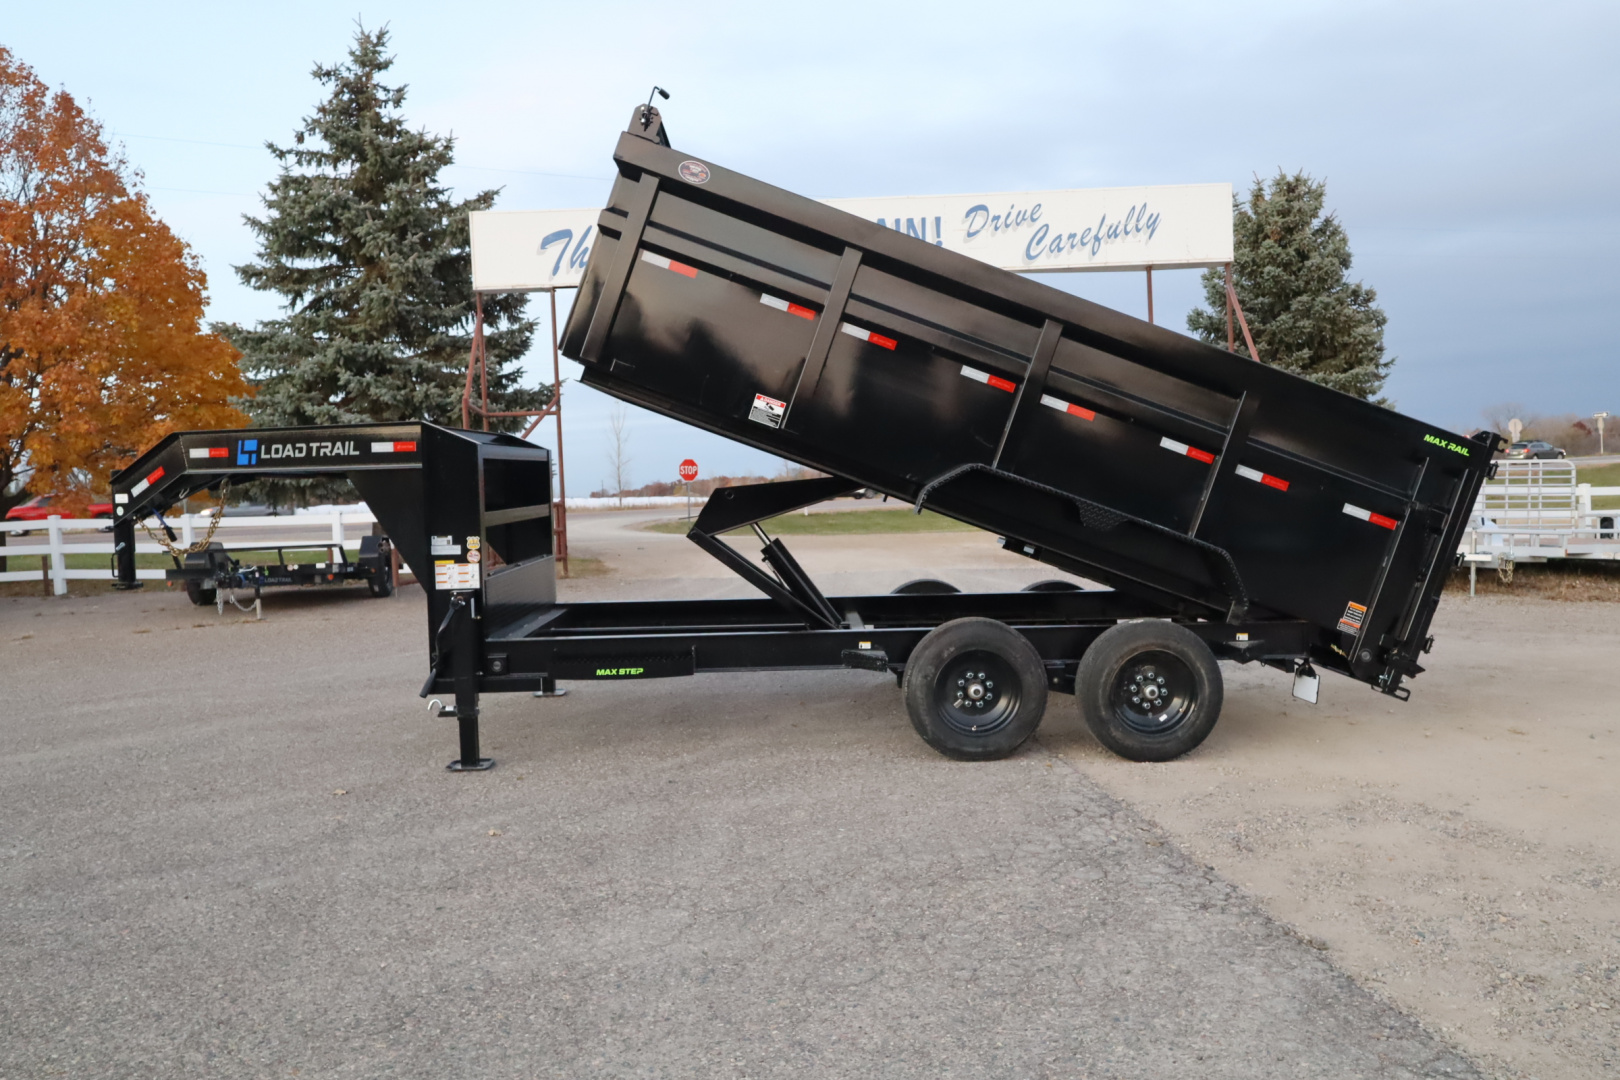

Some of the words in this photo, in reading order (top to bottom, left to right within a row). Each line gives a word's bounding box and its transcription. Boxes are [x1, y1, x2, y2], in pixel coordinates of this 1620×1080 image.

[876, 216, 943, 247] N!
[964, 203, 1042, 238] Drive
[1025, 202, 1160, 260] Carefully
[260, 443, 307, 459] LOAD
[309, 441, 360, 457] TRAIL
[1423, 434, 1448, 448] MAX
[1447, 442, 1470, 457] RAIL
[680, 465, 697, 475] STOP
[596, 668, 618, 676] MAX
[618, 667, 644, 675] STEP
